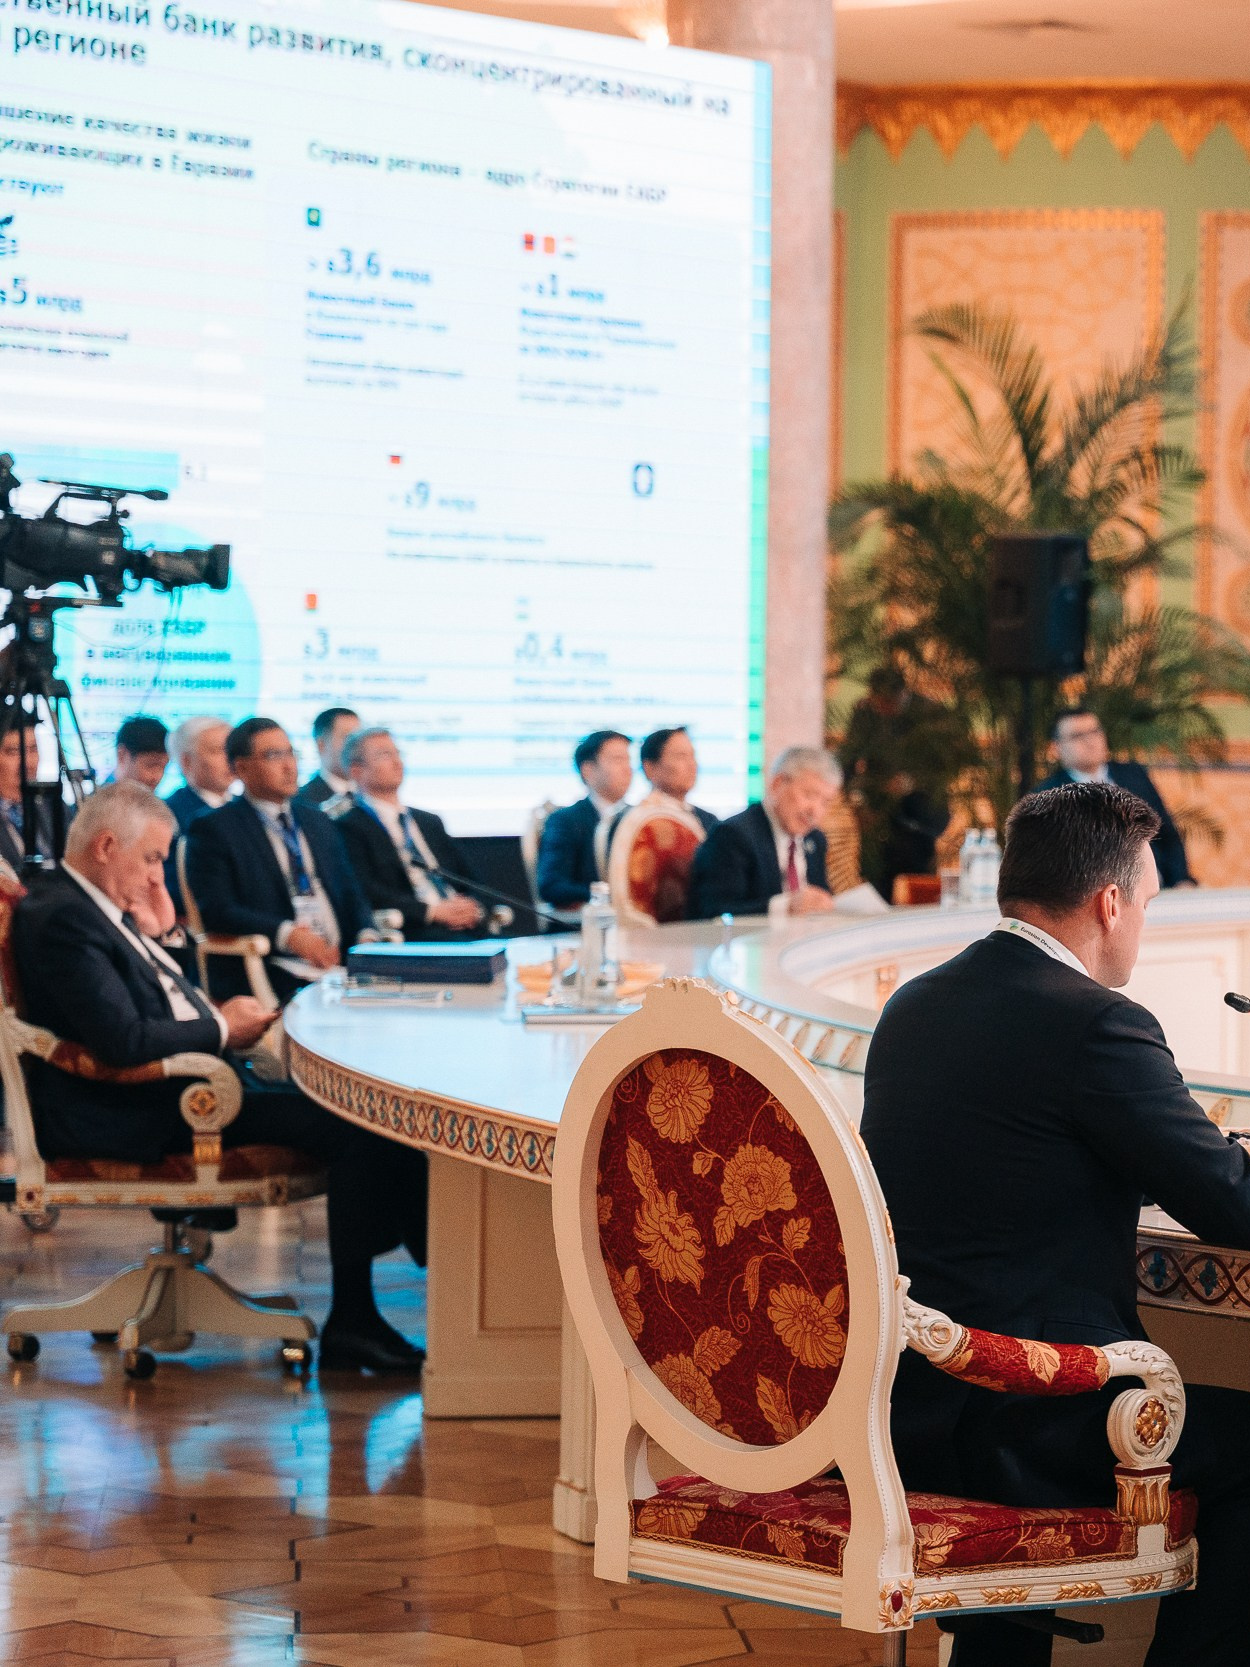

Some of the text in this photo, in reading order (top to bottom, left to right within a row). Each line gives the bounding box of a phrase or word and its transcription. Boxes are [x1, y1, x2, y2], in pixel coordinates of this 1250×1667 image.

[13, 26, 147, 66] регионе
[163, 3, 236, 38] банк
[249, 24, 392, 68] развития,
[1020, 926, 1063, 961] Eurasian Develop
